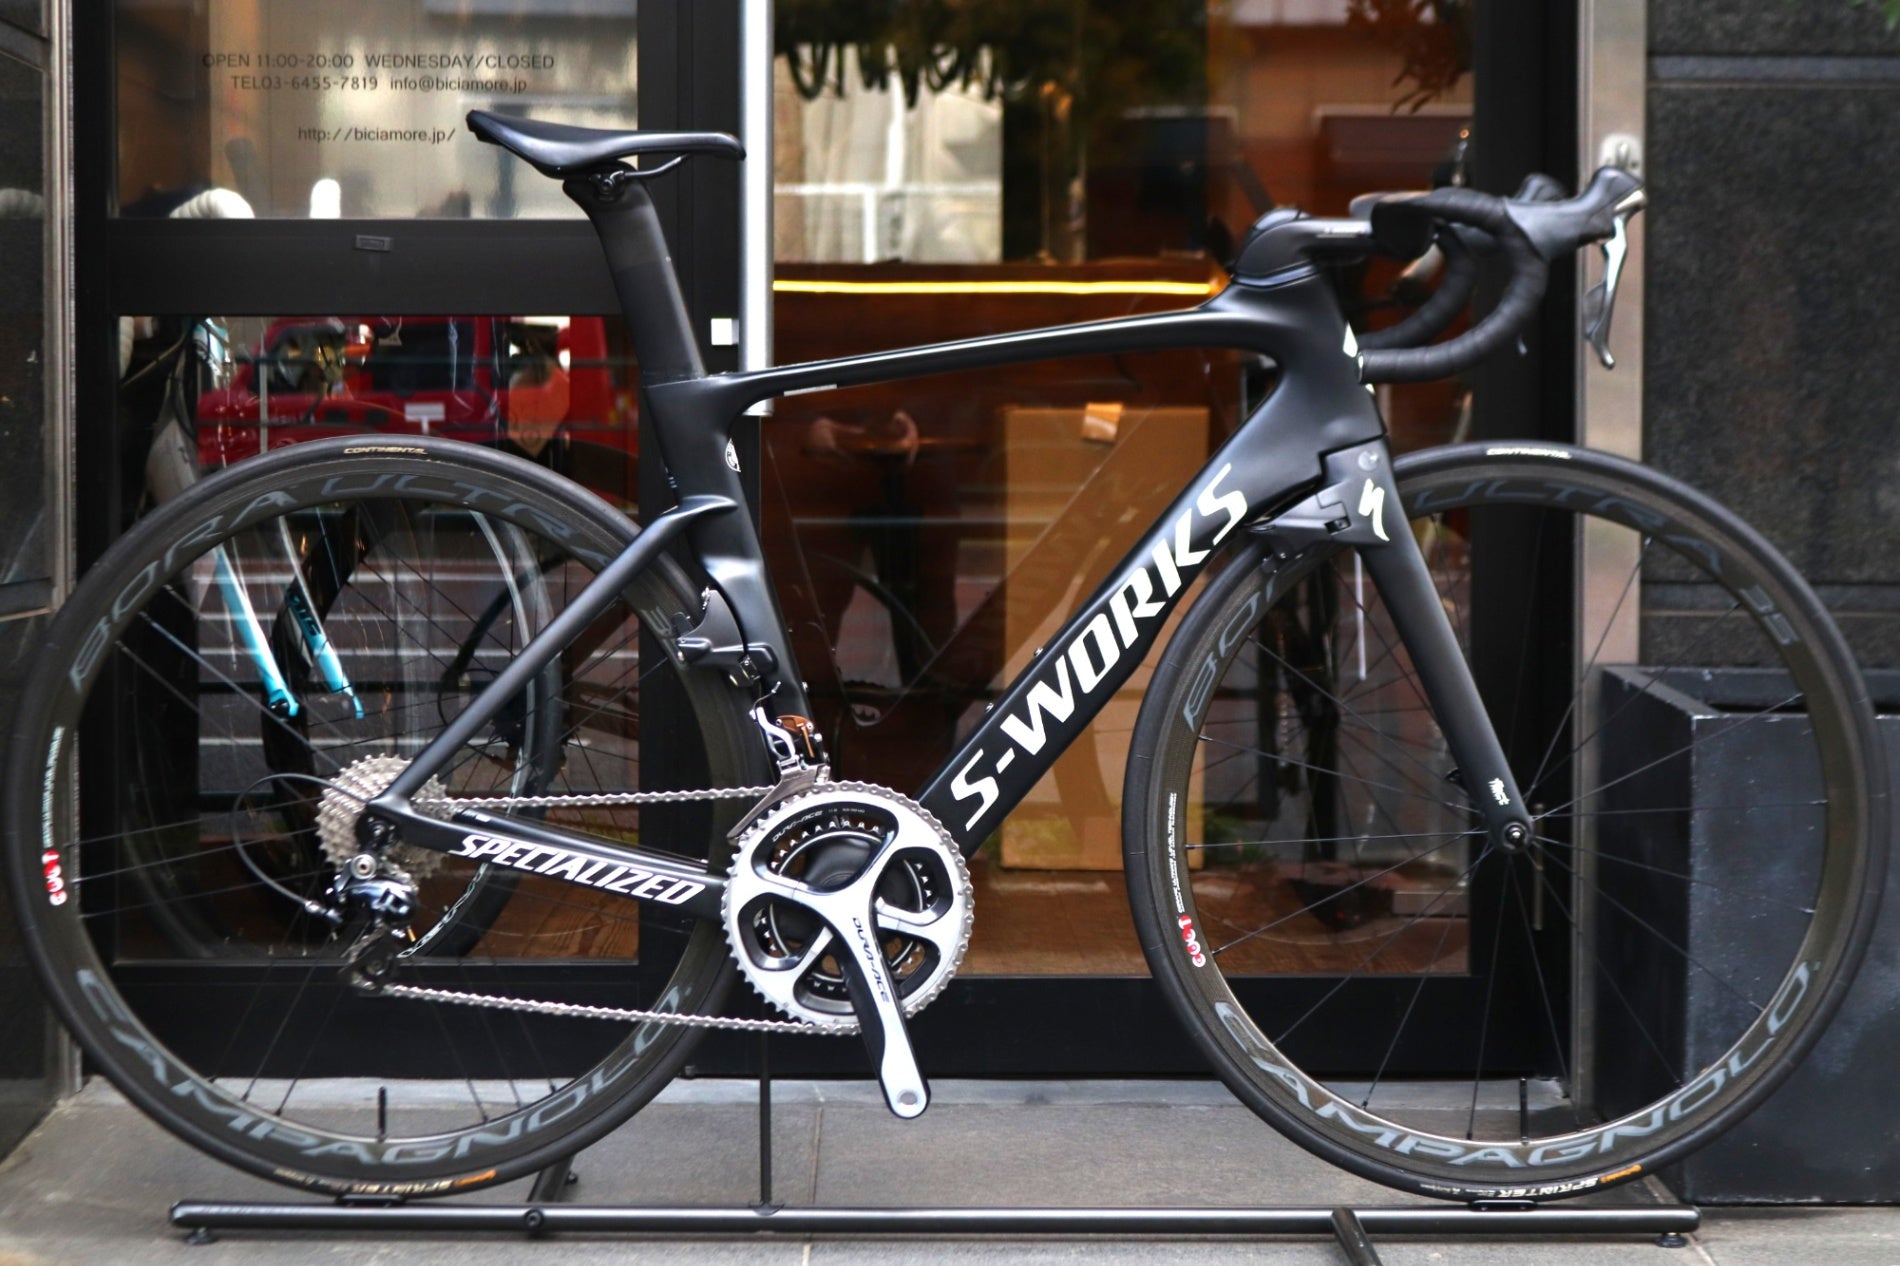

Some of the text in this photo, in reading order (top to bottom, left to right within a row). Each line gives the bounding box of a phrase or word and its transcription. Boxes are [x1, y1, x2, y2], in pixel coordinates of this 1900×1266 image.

[202, 54, 555, 68] OPEN 11:00-20:00 WEDNESDAY/CLOSED
[390, 76, 527, 93] info@biciamore.jp
[298, 126, 456, 144] http://biciamore.jp/
[69, 490, 298, 692] BORA
[950, 462, 1248, 832] S-WORKS
[448, 834, 706, 905] SPECIALIZED
[1214, 961, 1810, 1168] CAMPAGNOLO
